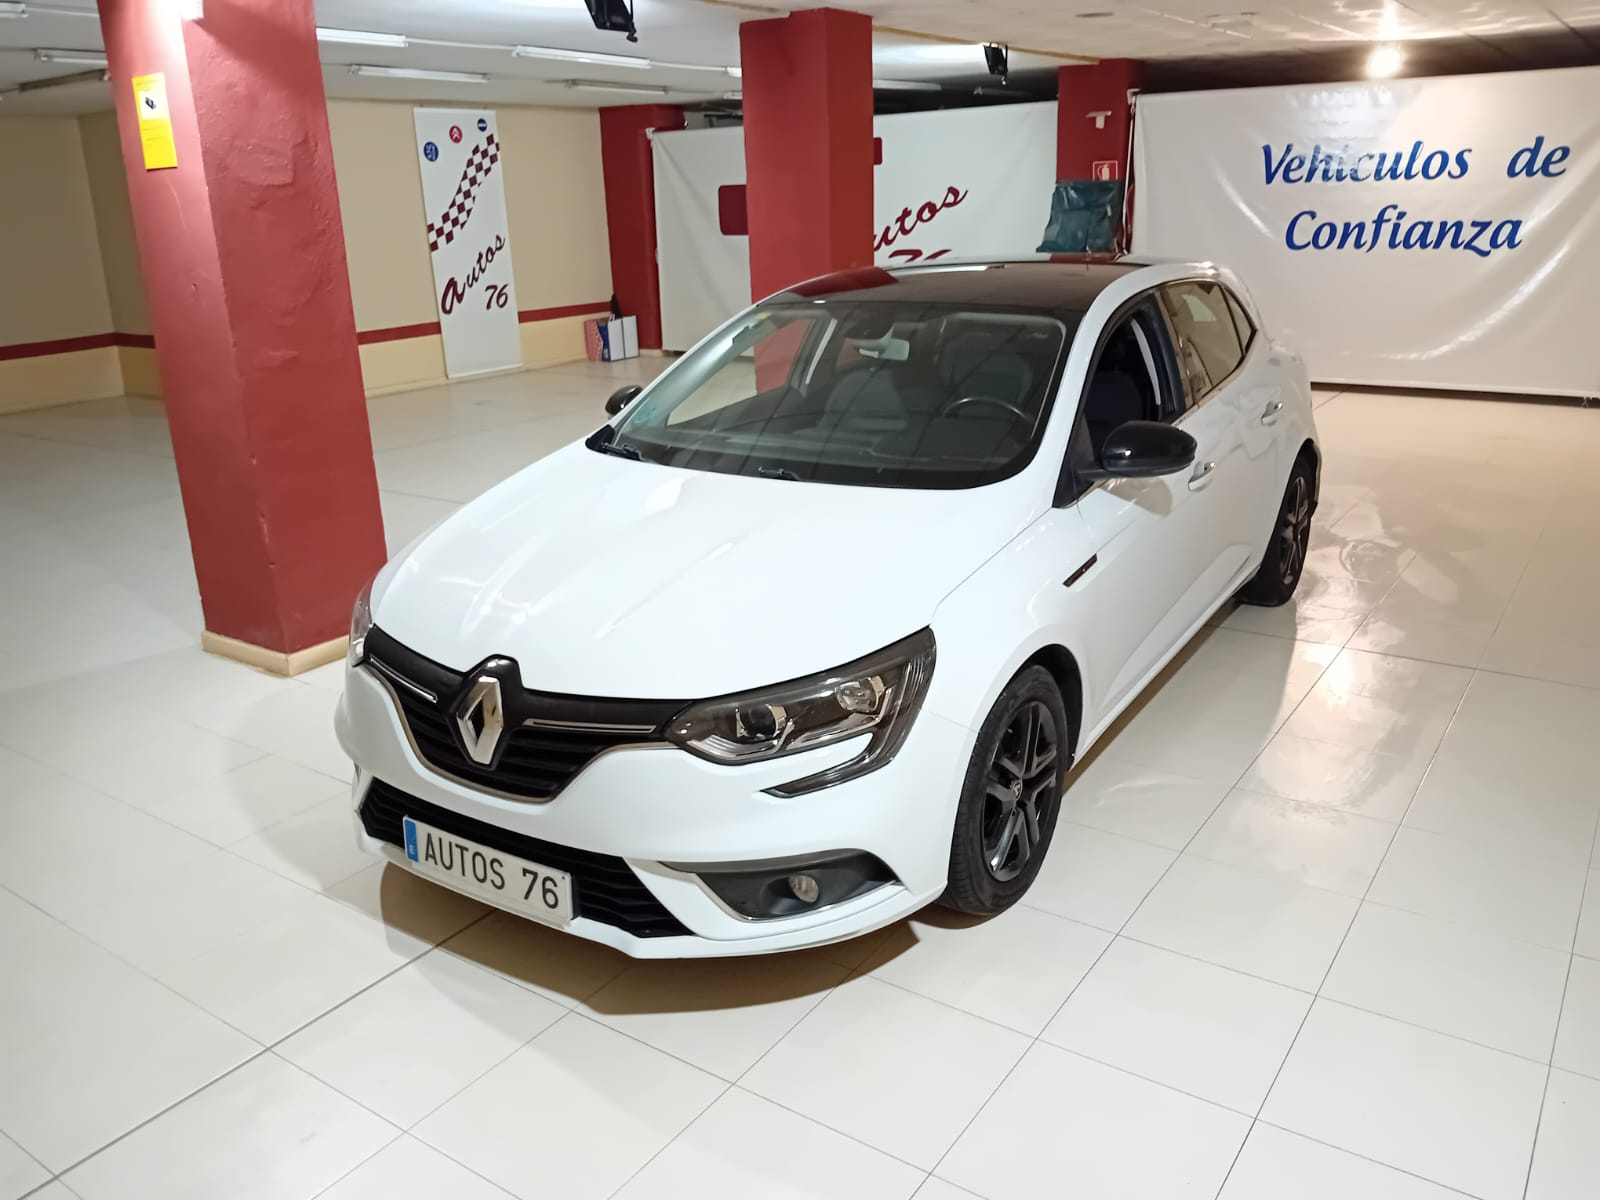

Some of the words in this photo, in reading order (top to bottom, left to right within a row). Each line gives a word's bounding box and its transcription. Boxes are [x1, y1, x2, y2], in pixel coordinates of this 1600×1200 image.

[1507, 136, 1570, 178] de
[873, 186, 968, 251] utos
[1285, 204, 1523, 257] Confianza
[485, 283, 509, 310] 76
[425, 832, 505, 890] AUTOS
[522, 867, 559, 909] 76
